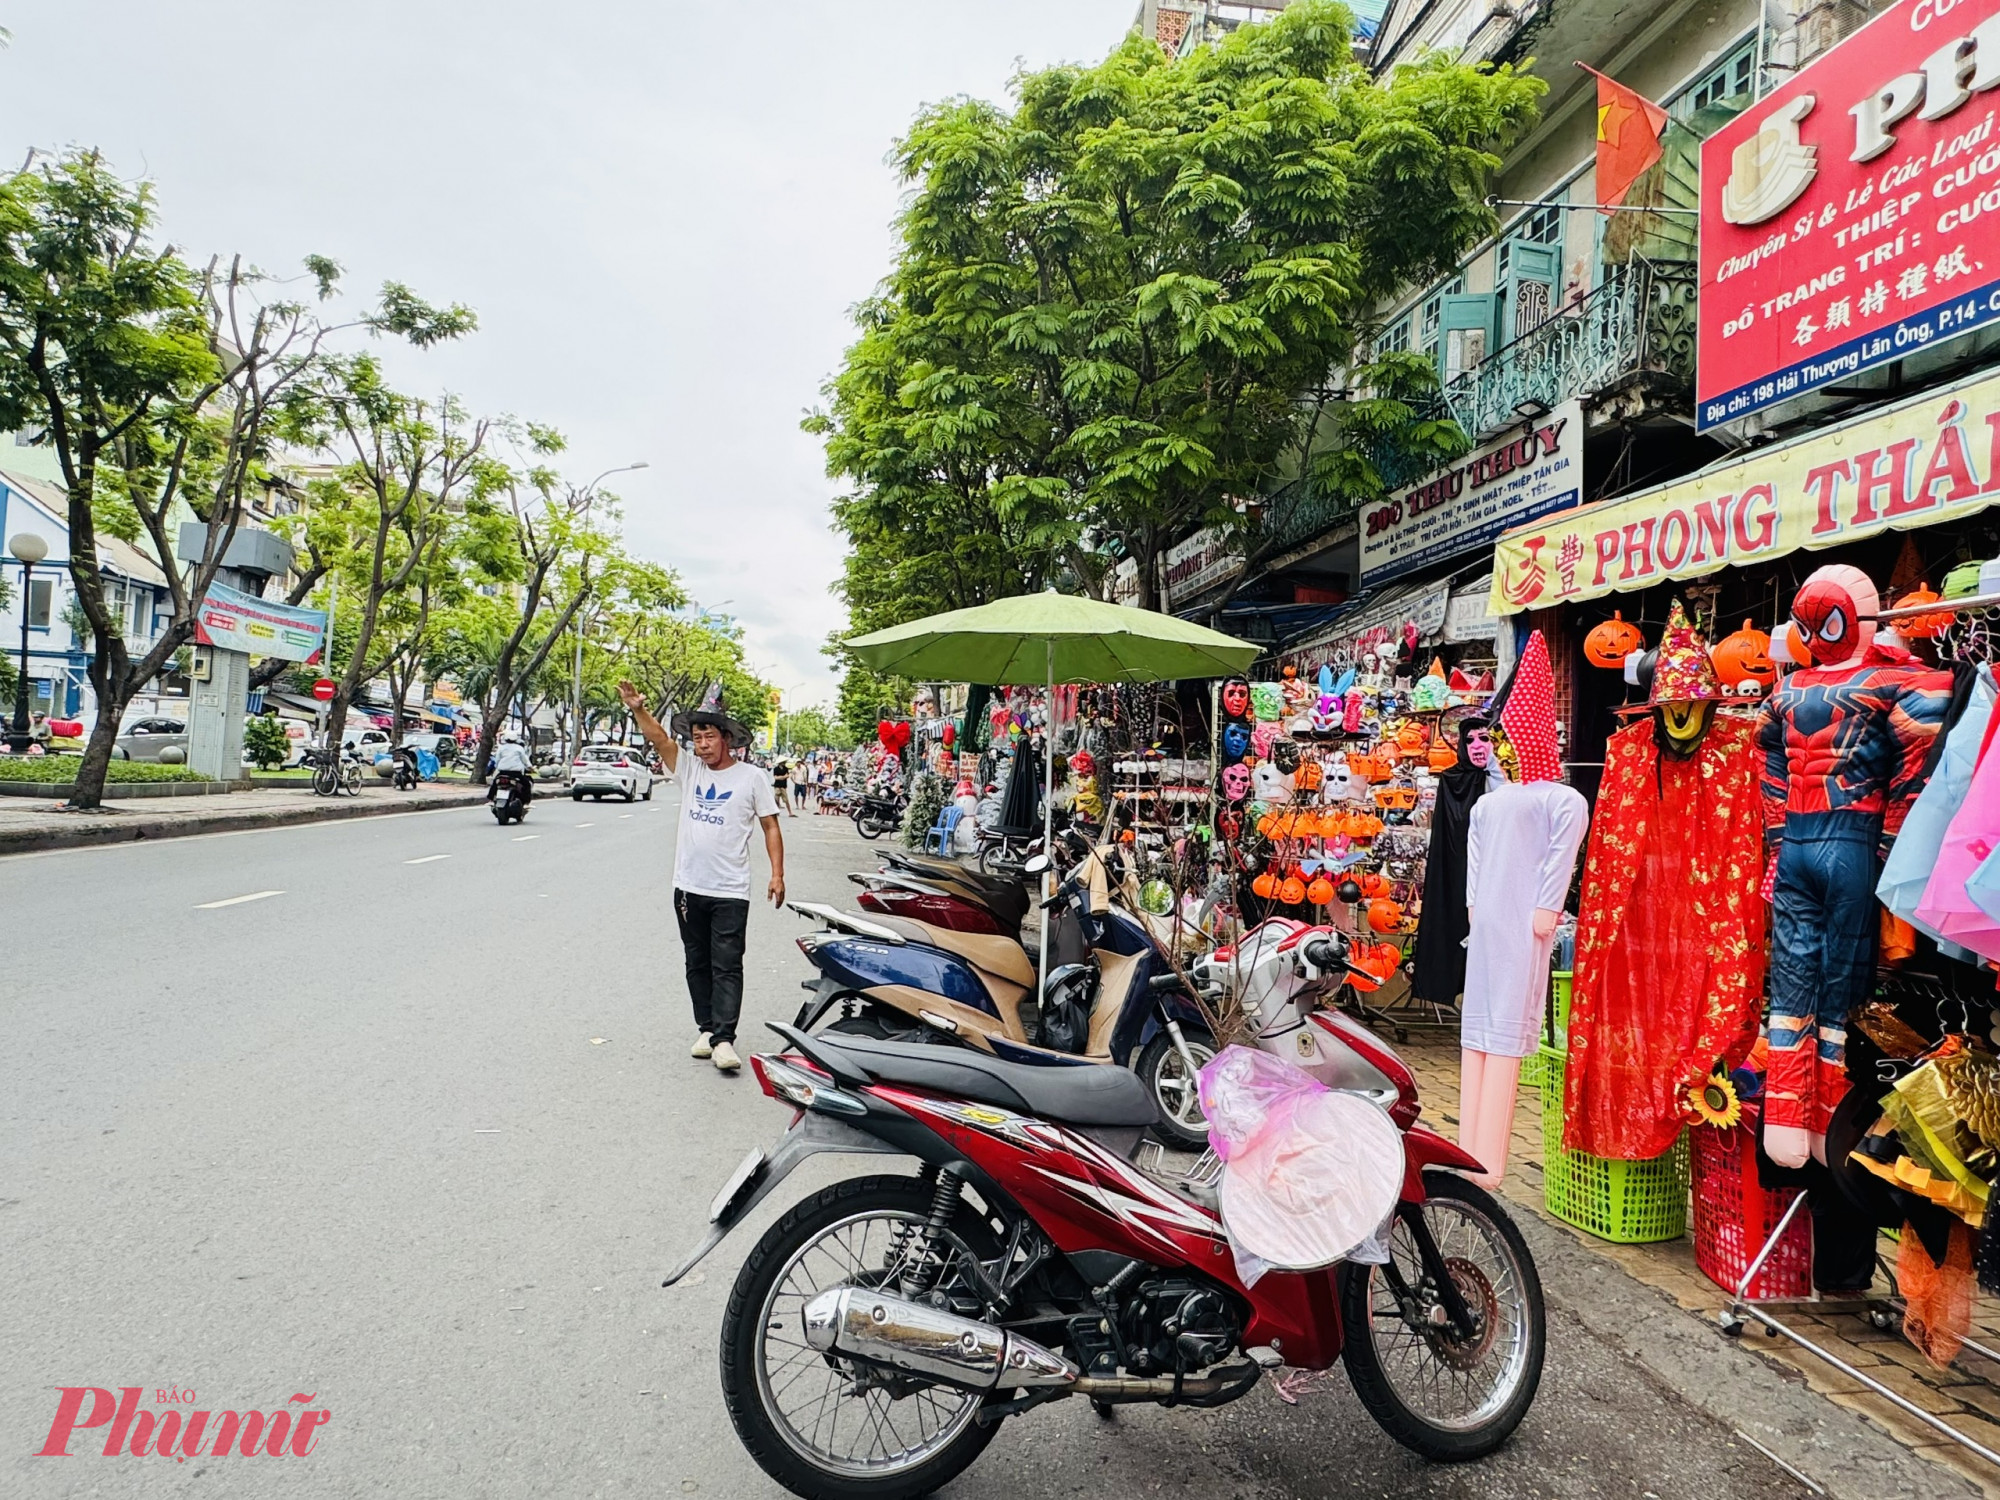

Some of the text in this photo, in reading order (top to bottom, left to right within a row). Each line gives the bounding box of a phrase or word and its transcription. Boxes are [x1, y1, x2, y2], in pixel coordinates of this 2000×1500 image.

[1716, 232, 1787, 284] Chuyên
[1817, 202, 1838, 229] &
[1878, 155, 1927, 194] Các
[1930, 110, 1995, 168] Loại
[1832, 191, 1922, 249] THIỆP
[1722, 302, 1755, 340] ĐỒ
[1760, 265, 1846, 319] TRANG
[1707, 402, 1726, 422] Địa
[1752, 381, 1774, 404] 198
[1776, 371, 1799, 395] Hải
[1801, 351, 1859, 385] Thượng
[1861, 338, 1891, 361] Lãn
[1895, 323, 1934, 348] Ông,
[1938, 299, 1976, 331] P.14
[1404, 467, 1466, 518] THU
[1466, 417, 1568, 489] THỦY
[1441, 504, 1462, 519] THIP
[1463, 496, 1480, 512] SINH
[1507, 474, 1532, 493] THIỆP
[1533, 464, 1552, 481] TÂN
[1553, 457, 1570, 472] GIA
[1483, 504, 1498, 517] GIA
[1502, 493, 1524, 509] NOEL
[1592, 482, 1778, 587] PHONG
[689, 809, 725, 826] didas
